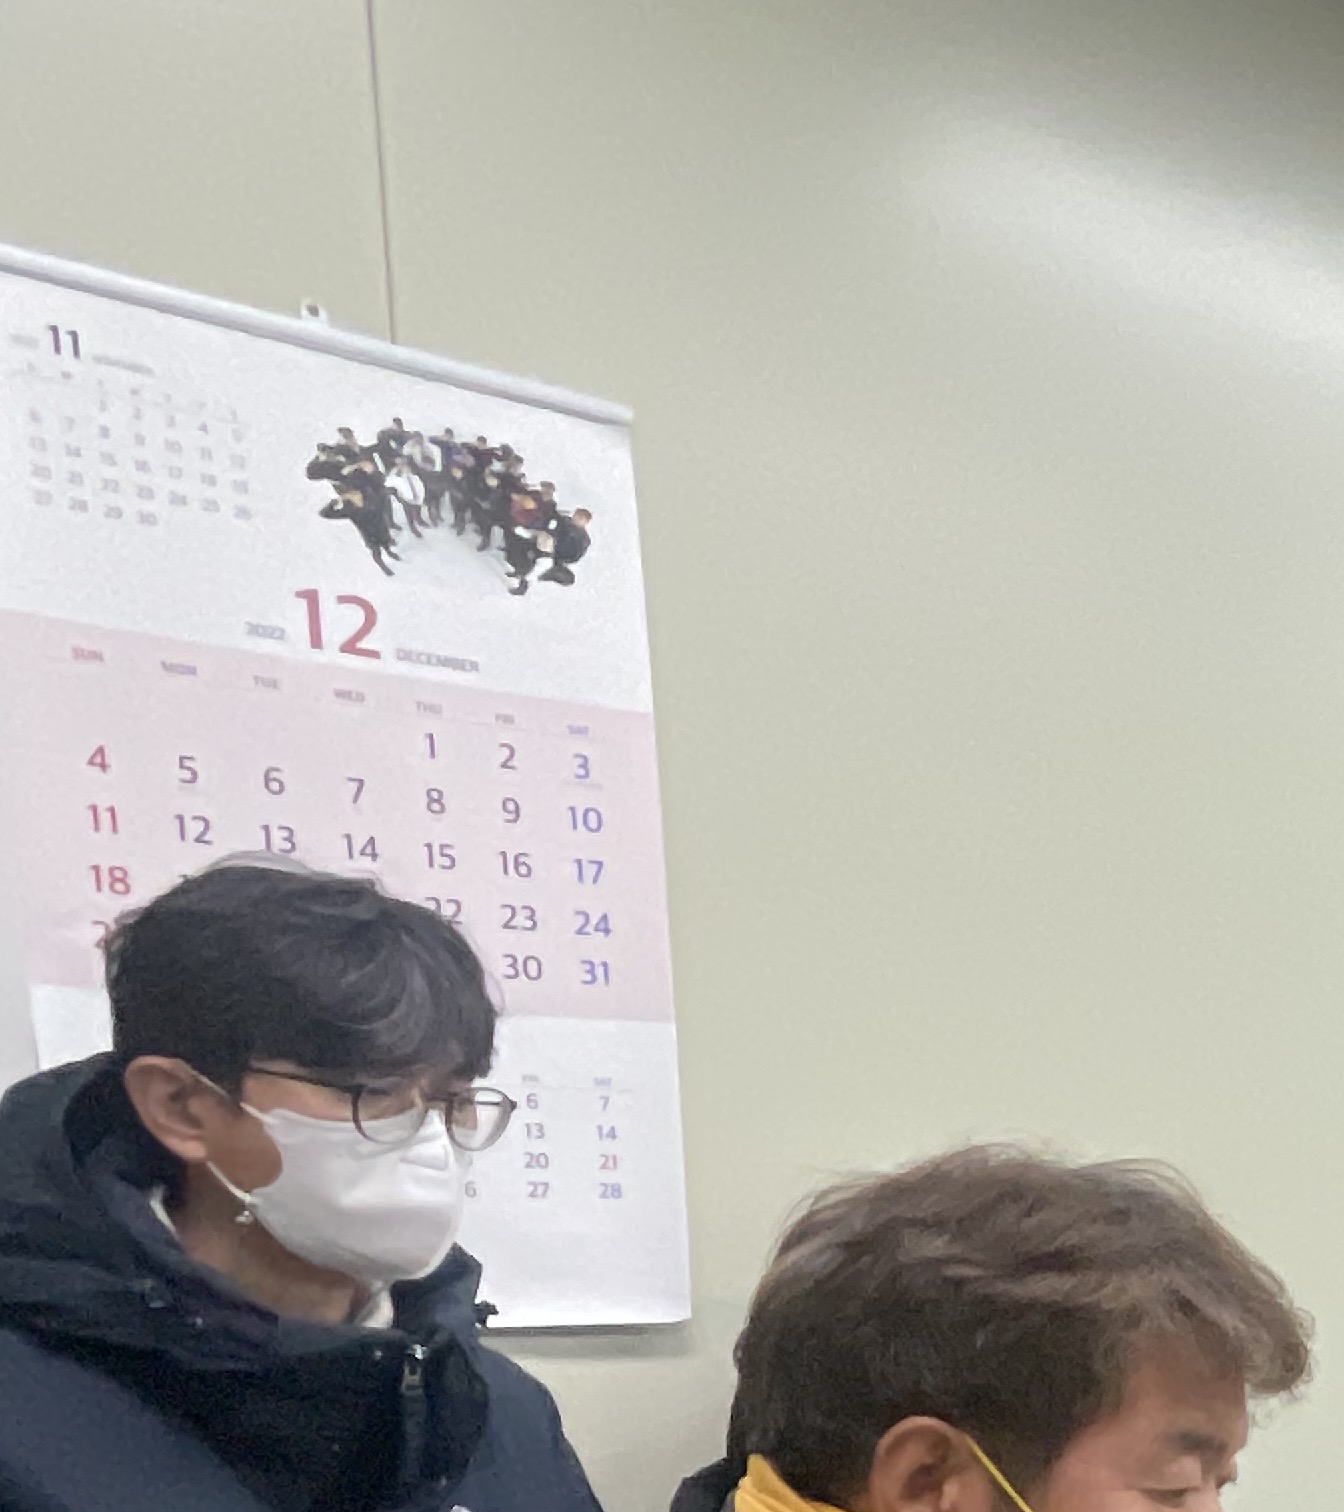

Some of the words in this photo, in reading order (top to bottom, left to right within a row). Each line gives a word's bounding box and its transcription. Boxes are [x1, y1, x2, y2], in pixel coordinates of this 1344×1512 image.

[48, 325, 80, 359] 11
[295, 589, 381, 659] 12
[395, 648, 480, 673] DECEMBER
[72, 647, 104, 663] SUN
[160, 661, 197, 676] MON
[426, 733, 435, 759] 1
[499, 743, 516, 770] 2
[574, 754, 590, 779] 3
[87, 745, 110, 773] 4
[179, 755, 198, 784] 5
[264, 767, 285, 796] 6
[347, 777, 364, 804] 7
[426, 788, 446, 814] 8
[502, 797, 520, 823] 9
[568, 806, 603, 833] 10
[88, 804, 118, 834] 11
[175, 814, 212, 845] 12
[261, 824, 297, 850] 13
[344, 834, 379, 862] 14
[424, 843, 456, 870] 15
[499, 851, 532, 878] 16
[575, 859, 603, 884] 17
[91, 865, 131, 895] 18
[501, 904, 537, 931] 23
[575, 911, 612, 937] 24
[503, 954, 542, 981] 30
[581, 960, 609, 985] 31
[526, 1093, 538, 1109] 6
[600, 1096, 609, 1111] 7
[525, 1123, 545, 1139] 13
[597, 1125, 617, 1140] 14
[525, 1152, 550, 1169] 20
[600, 1154, 617, 1170] 21
[528, 1182, 550, 1198] 27
[600, 1183, 623, 1199] 28
